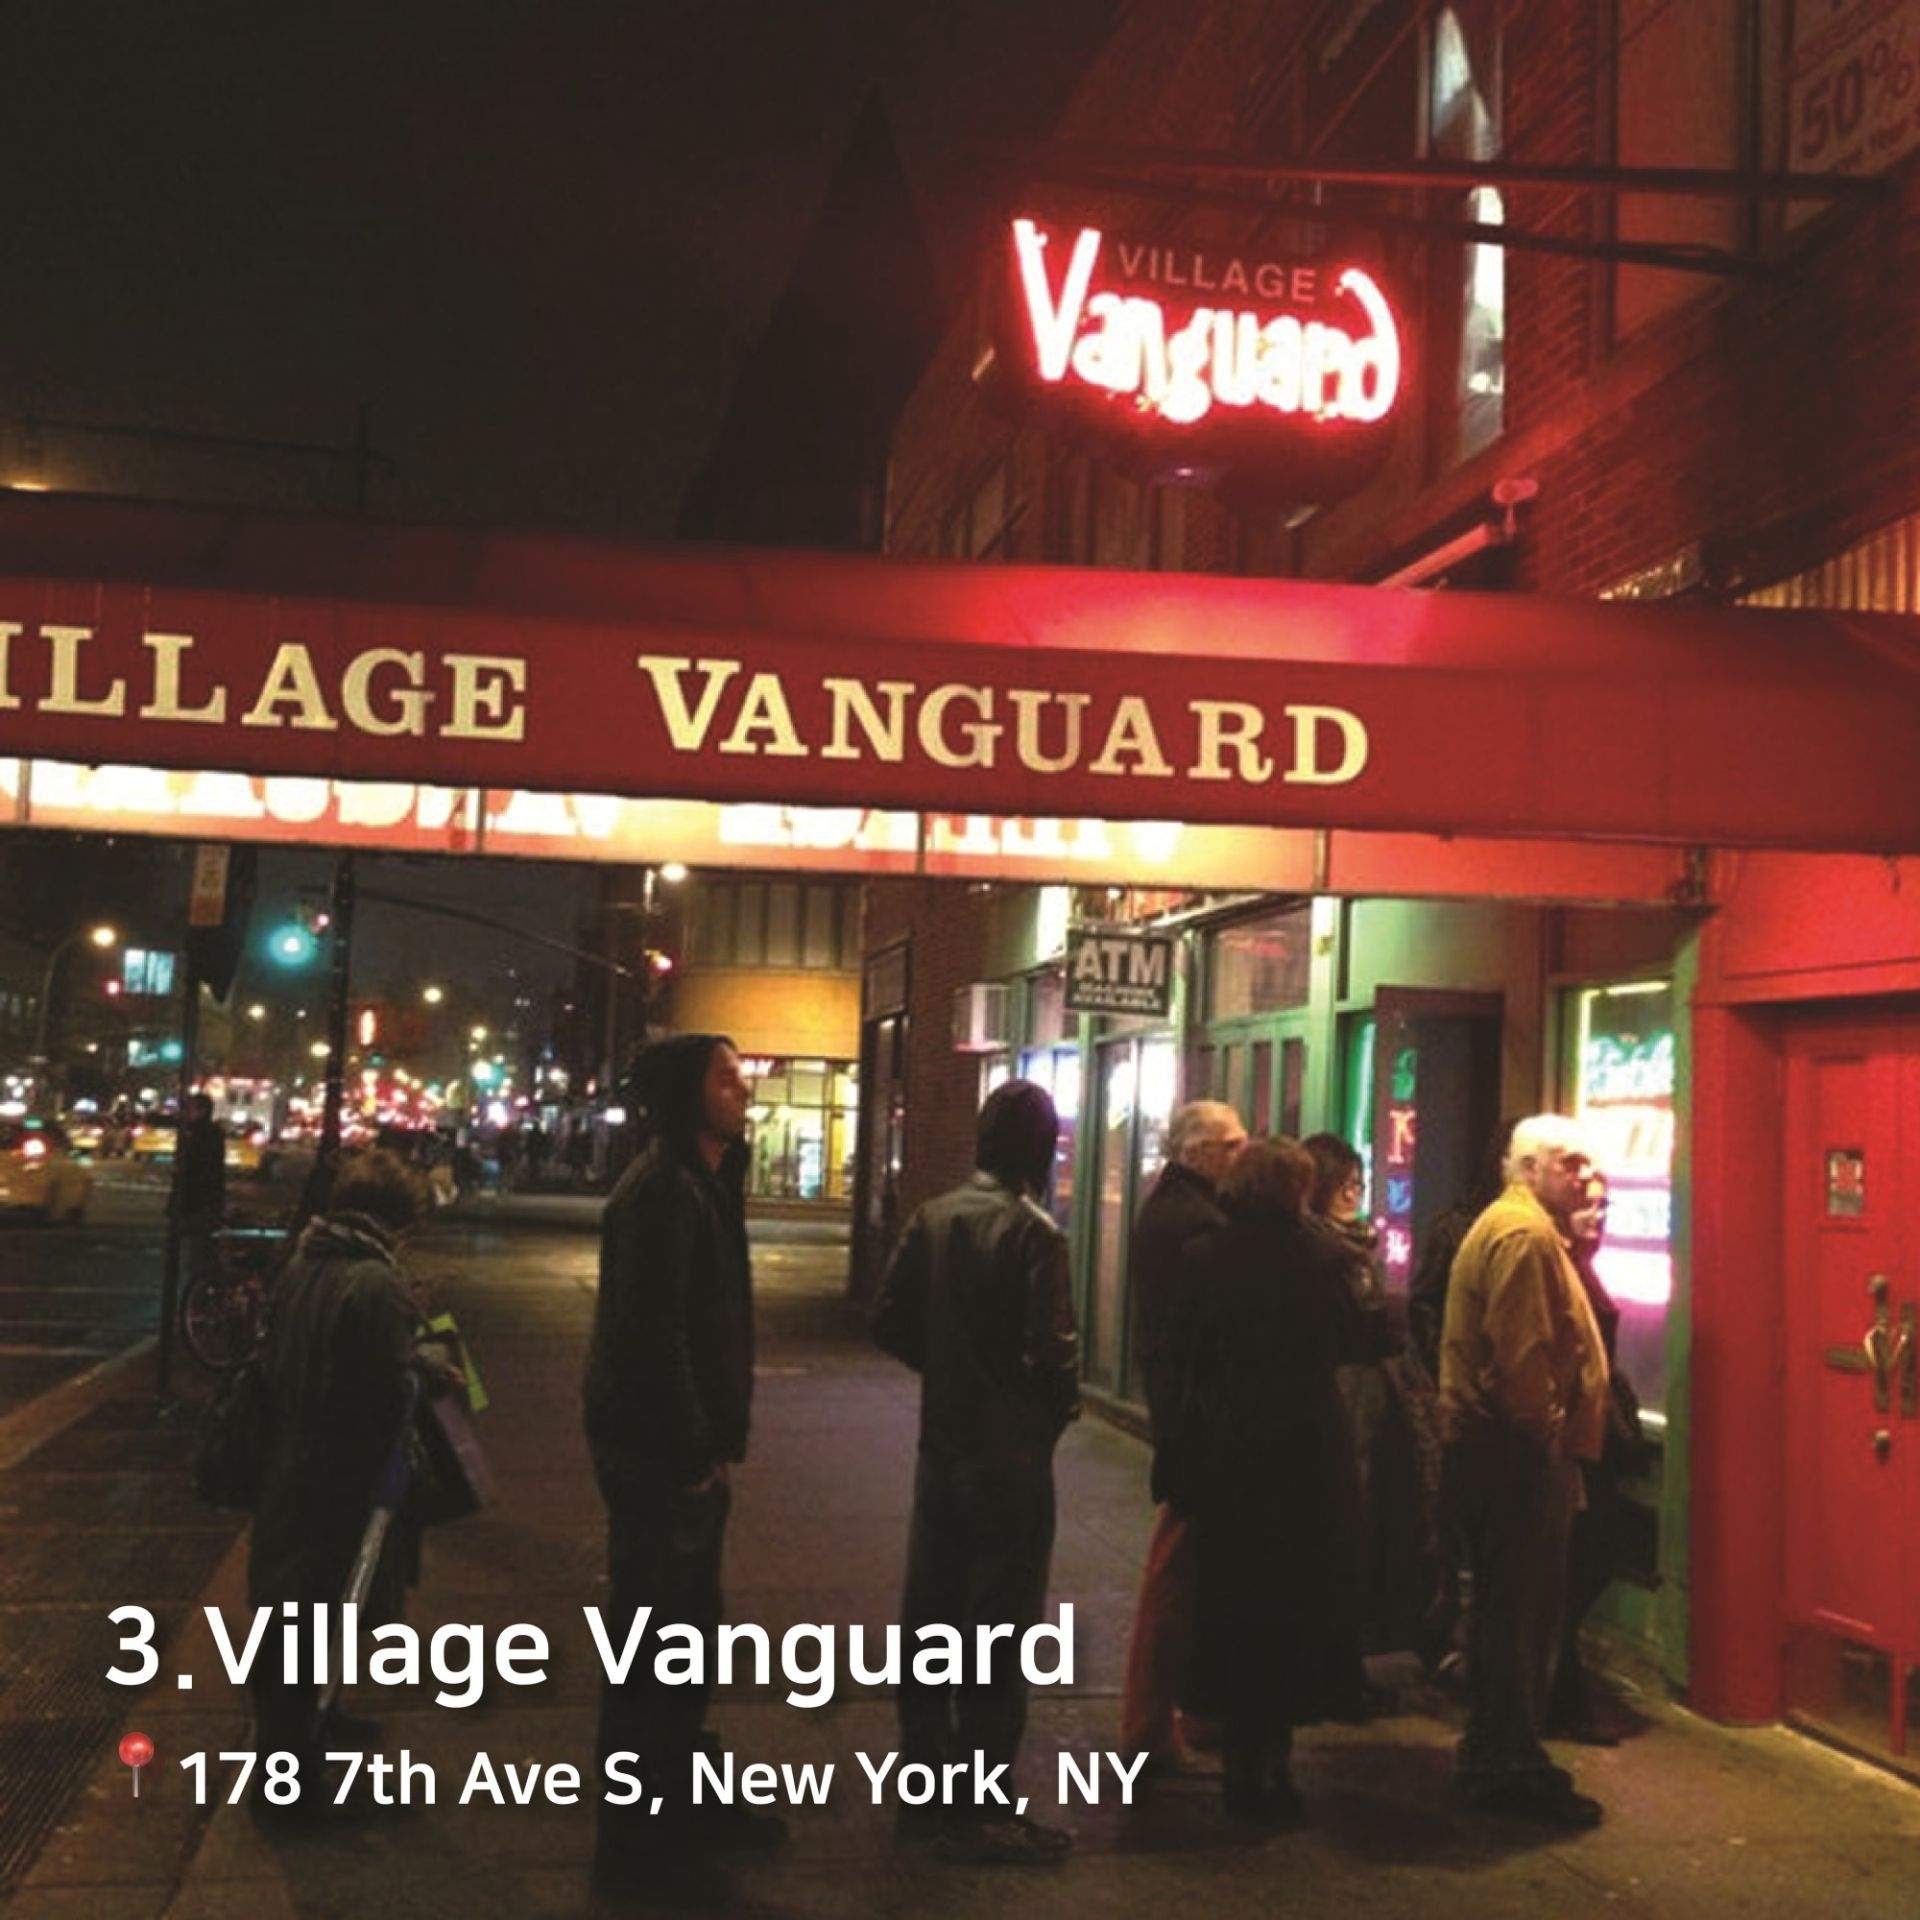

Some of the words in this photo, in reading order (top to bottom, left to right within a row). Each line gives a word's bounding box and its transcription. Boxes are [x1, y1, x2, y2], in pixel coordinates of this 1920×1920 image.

[1118, 244, 1317, 302] VILLAGE
[1012, 218, 1400, 424] Vanguard
[638, 655, 1369, 786] VANGUARD
[1074, 938, 1166, 985] ATM
